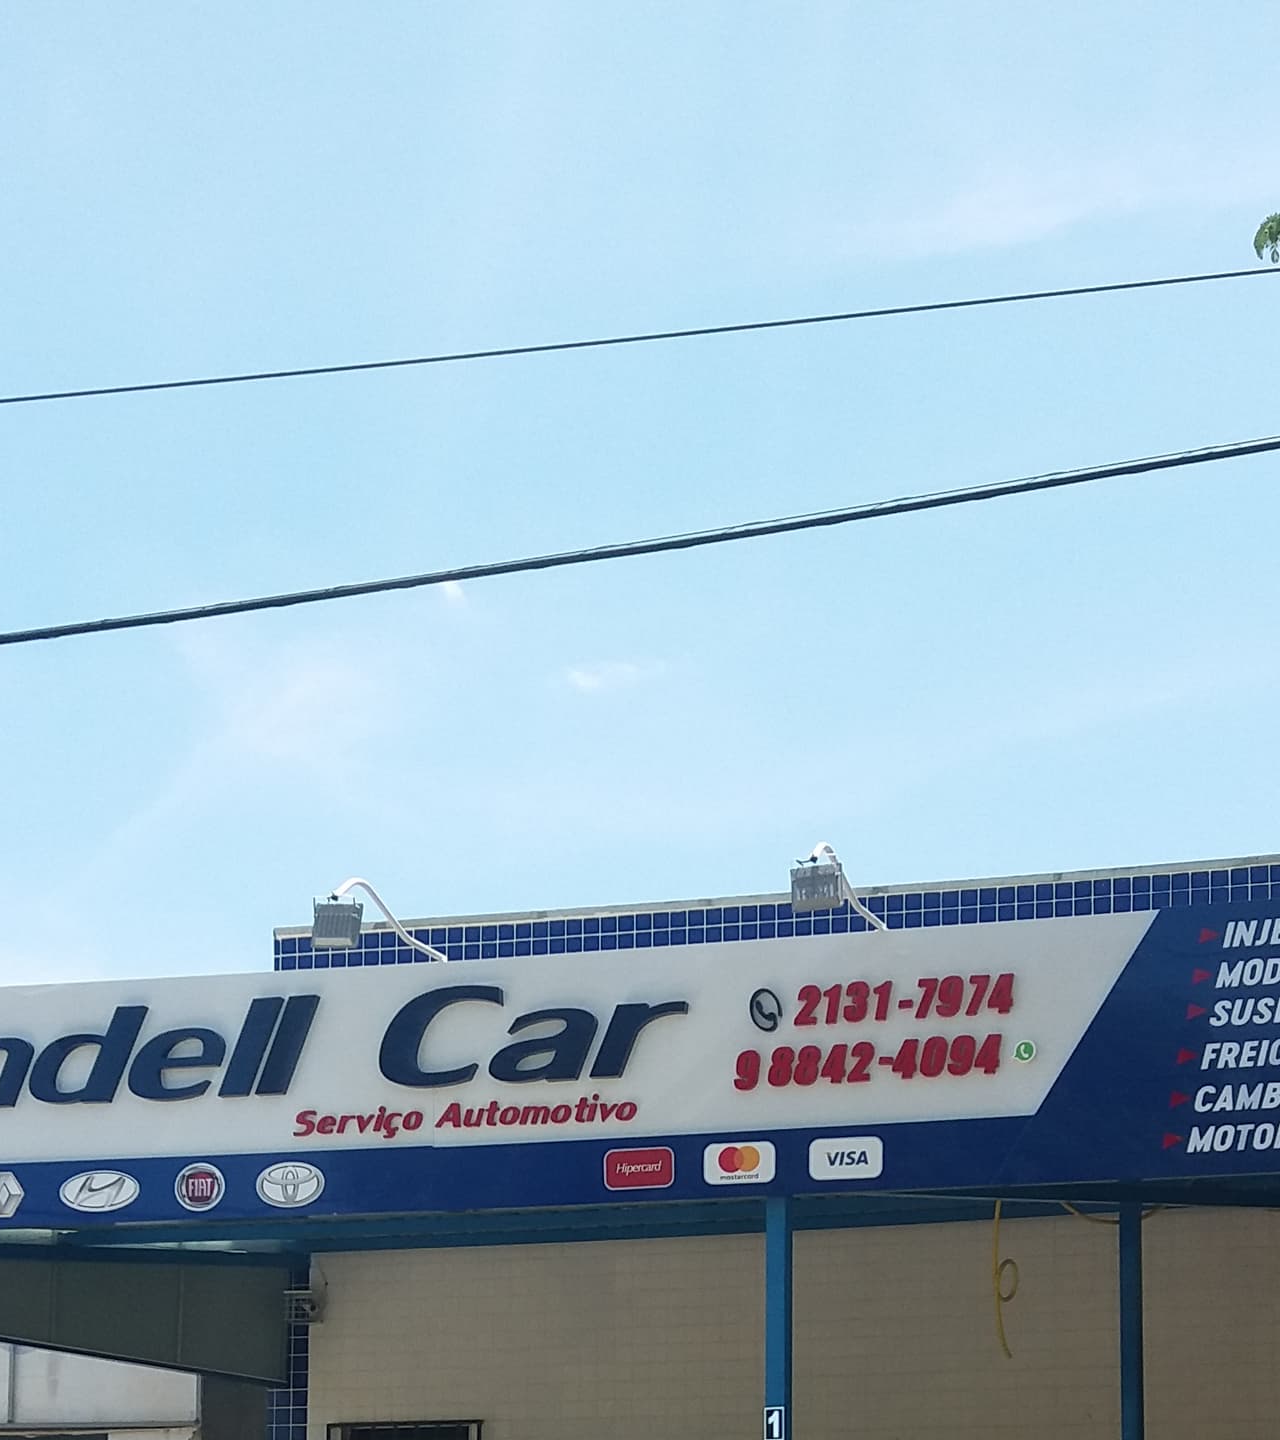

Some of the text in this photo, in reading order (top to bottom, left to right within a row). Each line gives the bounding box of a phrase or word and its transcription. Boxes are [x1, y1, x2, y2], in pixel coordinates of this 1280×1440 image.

[793, 973, 1015, 1028] 2131-7974
[378, 985, 689, 1089] Car
[293, 1096, 639, 1138] Serviço Automotivo
[616, 1160, 663, 1175] Hipercard
[826, 1151, 869, 1167] VISA
[188, 1177, 213, 1198] FIAT
